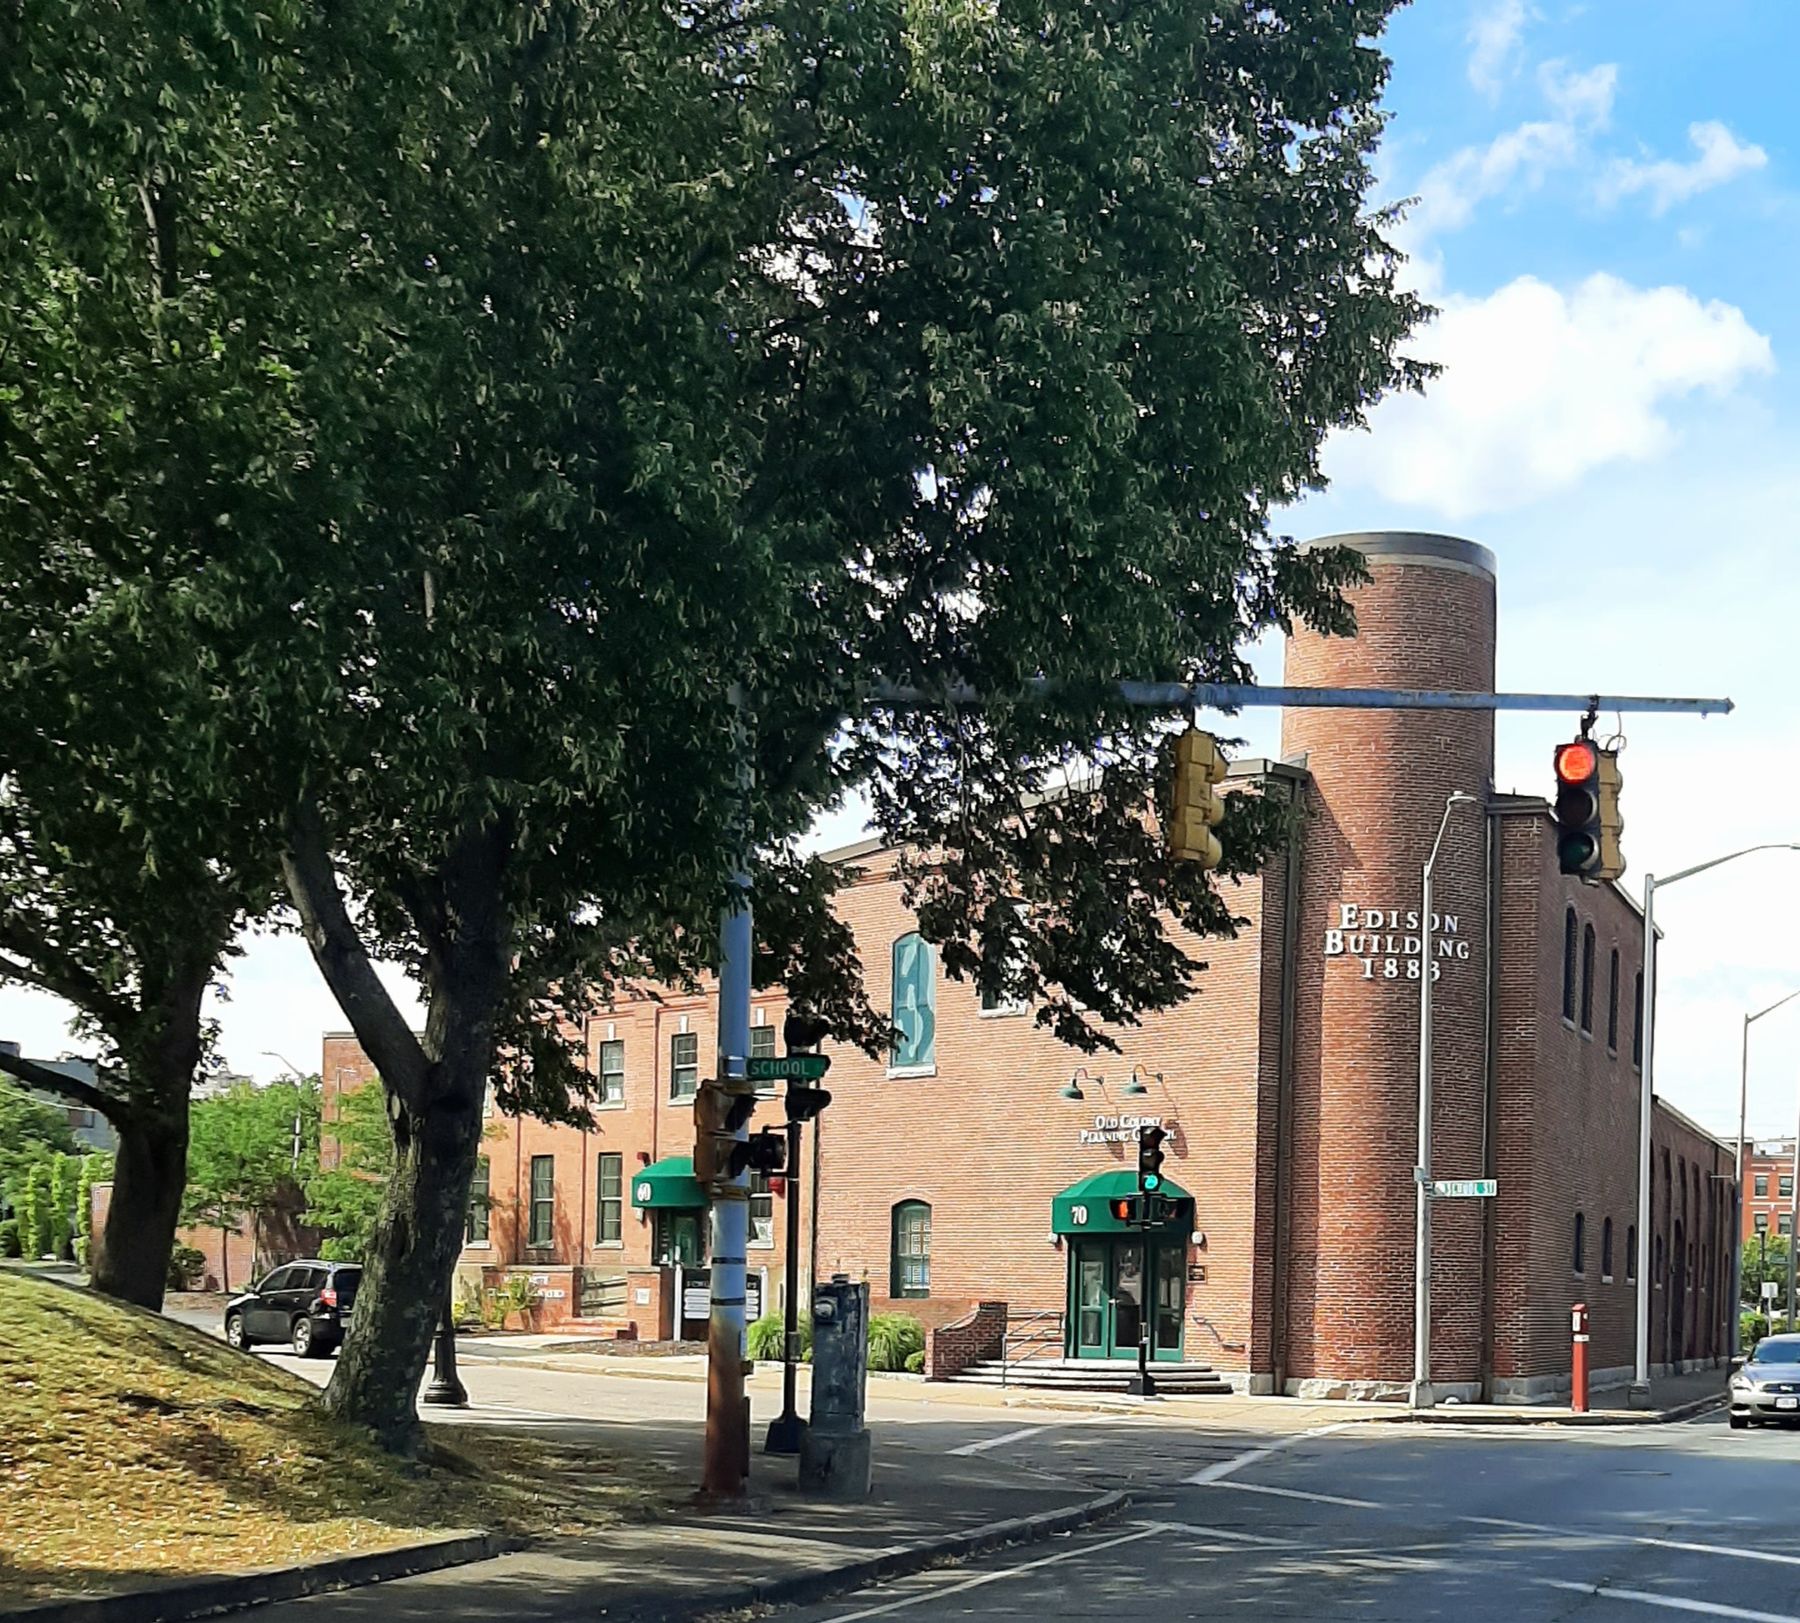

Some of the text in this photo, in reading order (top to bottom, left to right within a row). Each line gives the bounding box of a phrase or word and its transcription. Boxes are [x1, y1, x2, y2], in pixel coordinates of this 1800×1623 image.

[1339, 903, 1458, 933] EDISON
[1324, 929, 1469, 959] BUILDNG
[751, 1060, 810, 1076] SCHOOL
[1071, 1205, 1088, 1225] 70
